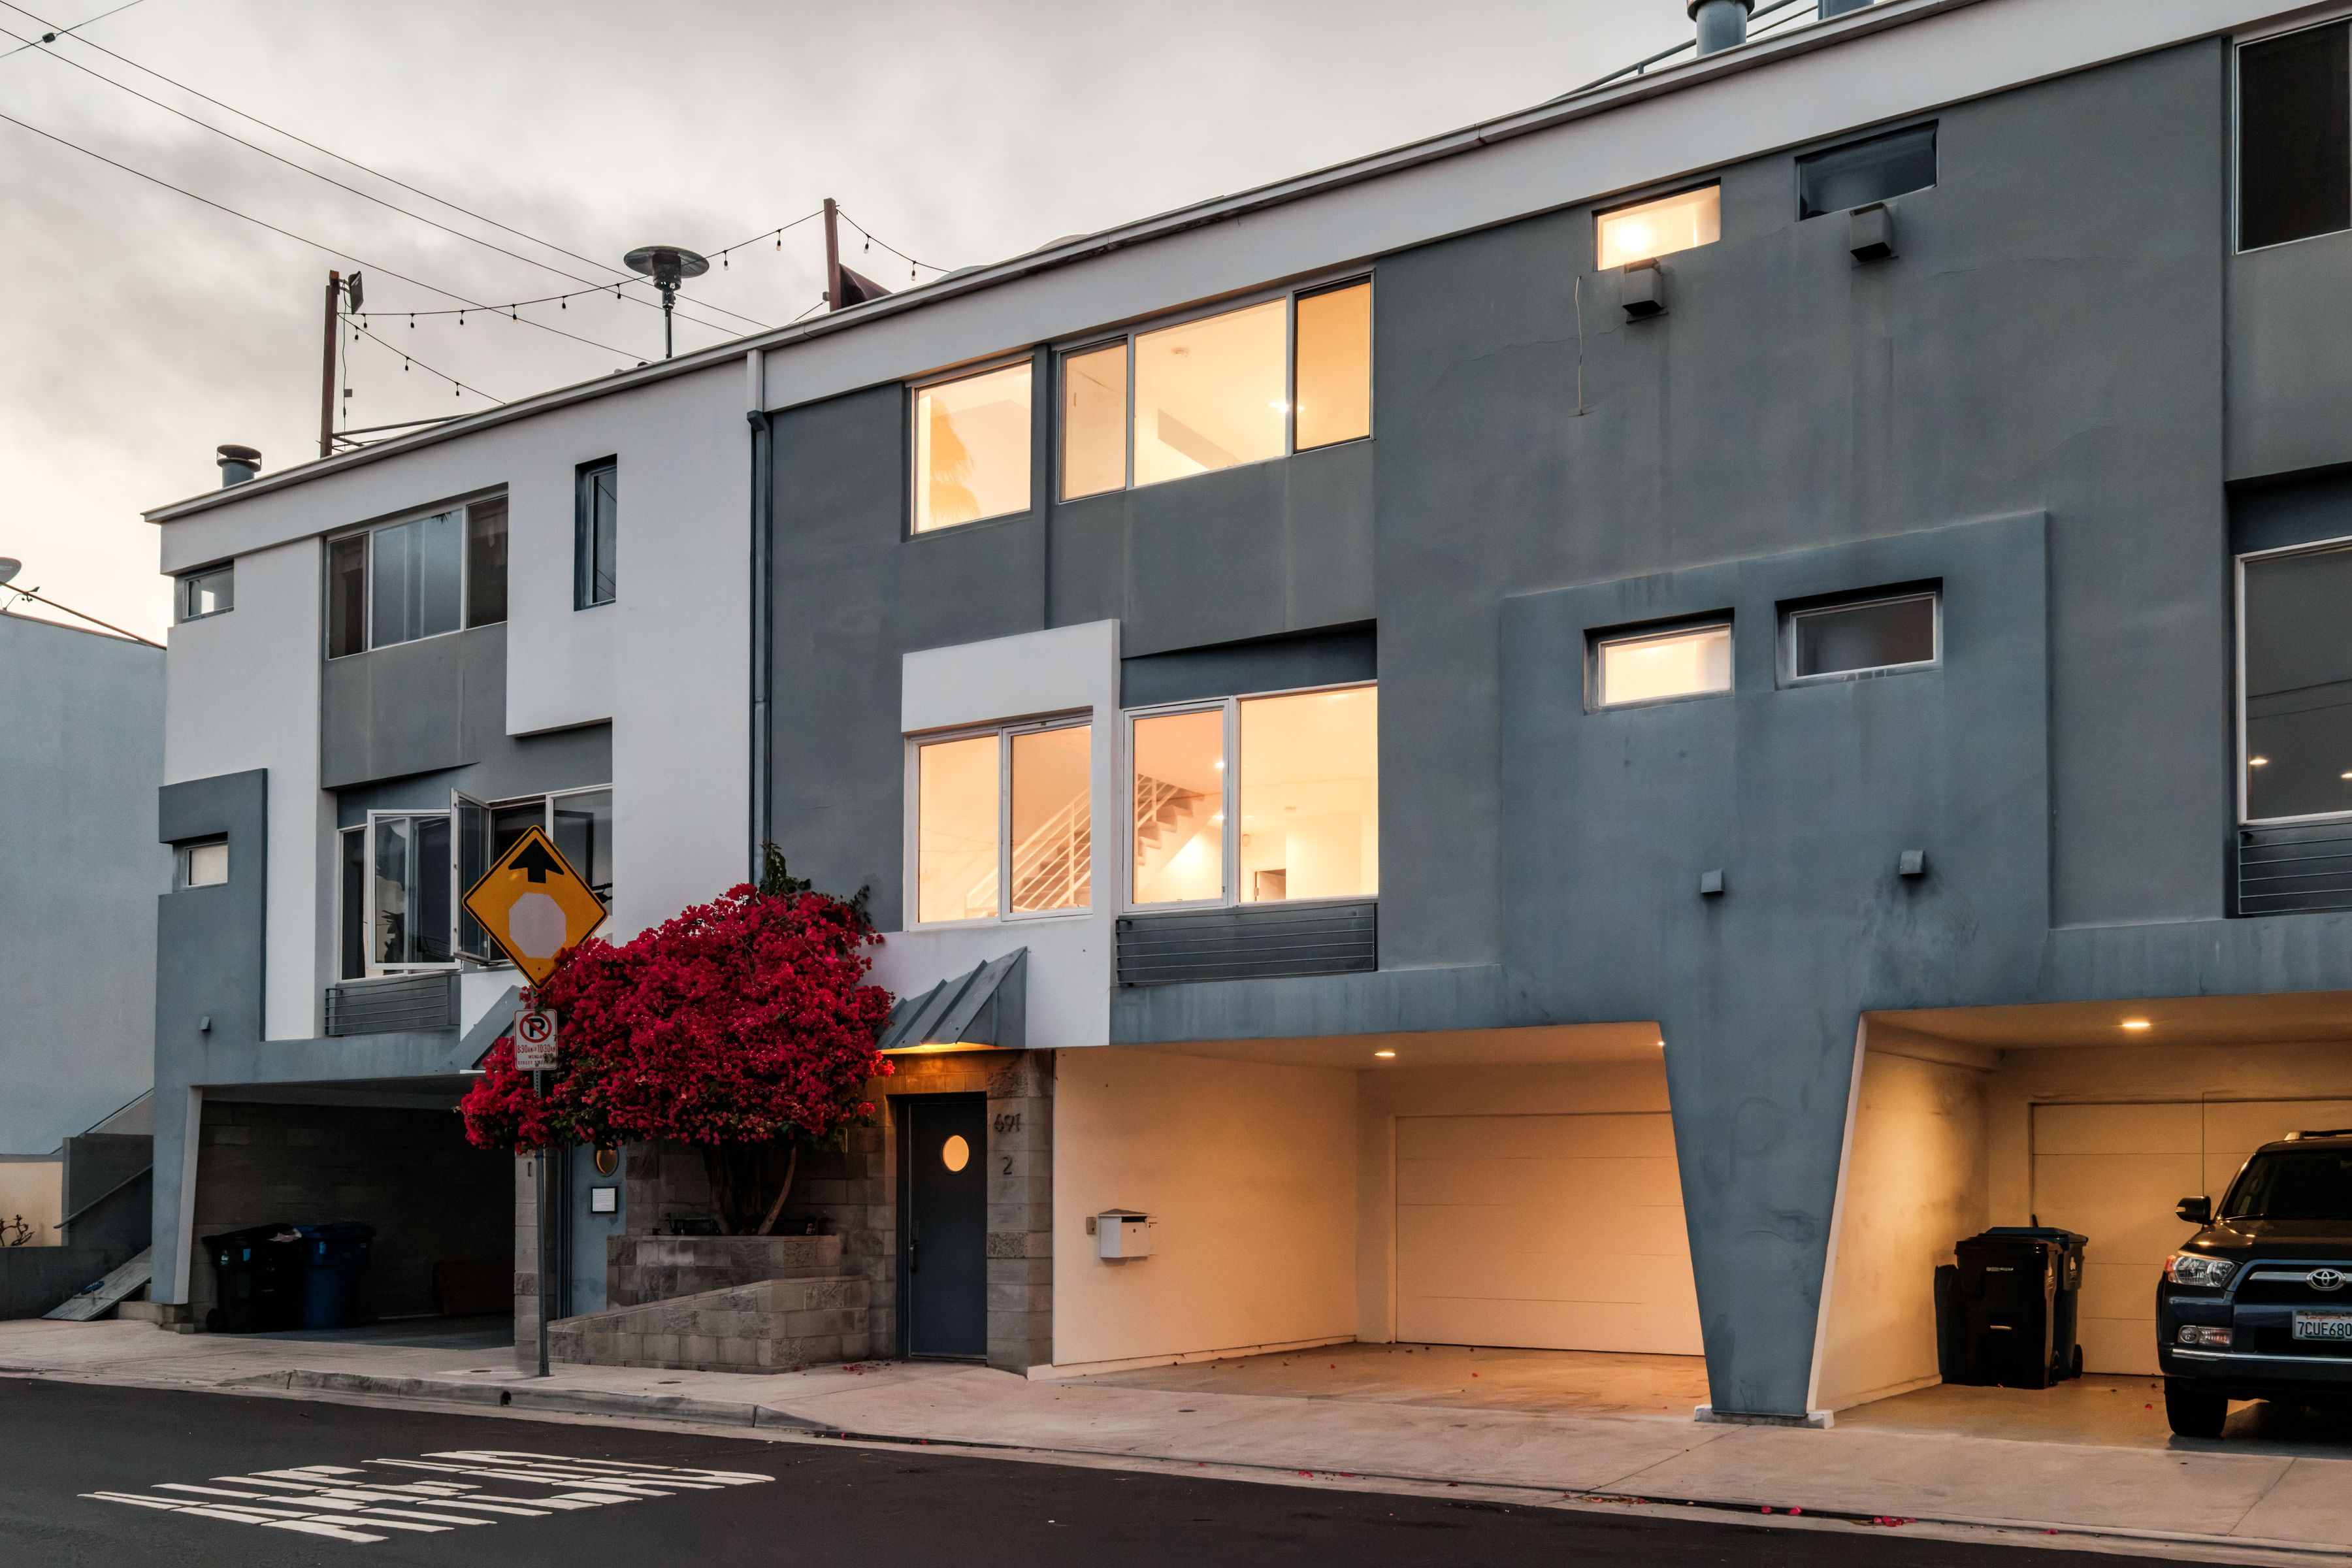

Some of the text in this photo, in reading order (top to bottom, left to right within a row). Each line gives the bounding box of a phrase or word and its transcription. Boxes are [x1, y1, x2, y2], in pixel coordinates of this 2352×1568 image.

[529, 1018, 546, 1037] P
[994, 1113, 1021, 1132] 691
[1002, 1155, 1013, 1175] 2
[2297, 1322, 2352, 1337] 7CUE680
[77, 1450, 776, 1543] AHEAD
